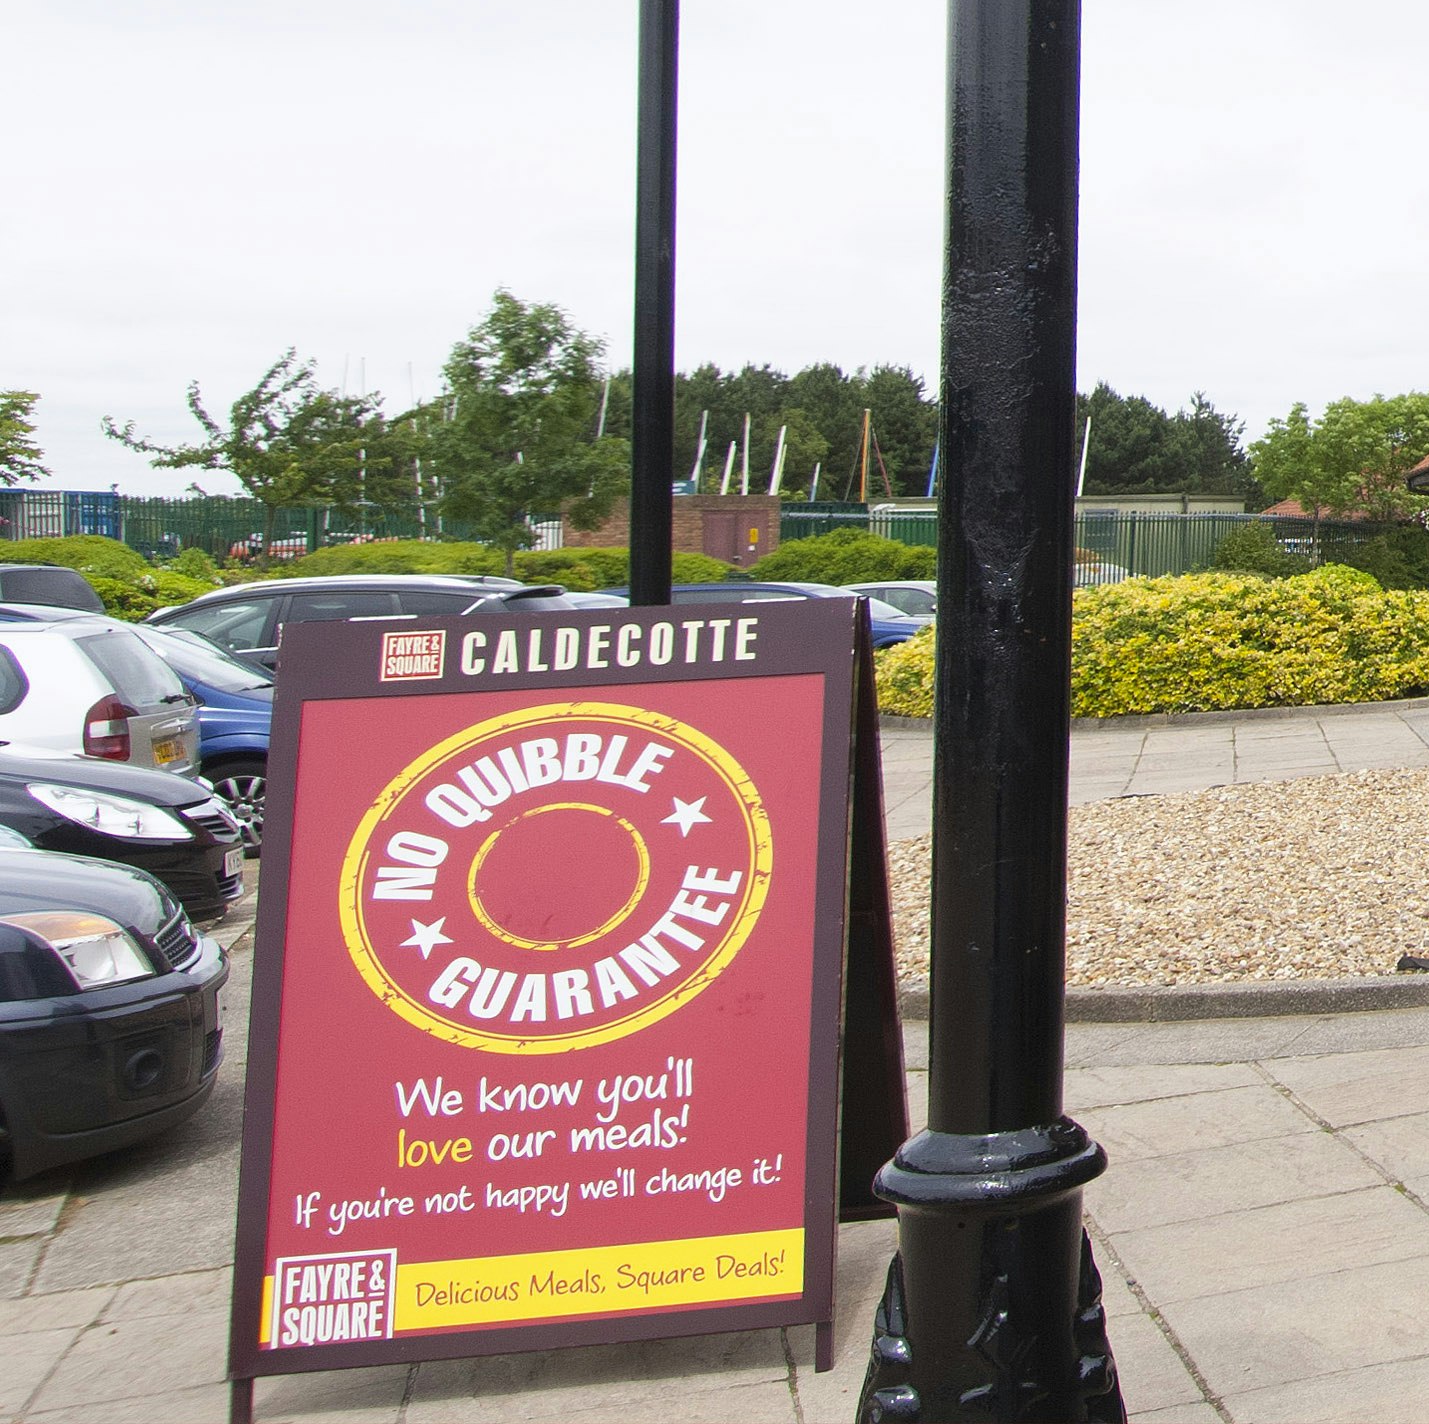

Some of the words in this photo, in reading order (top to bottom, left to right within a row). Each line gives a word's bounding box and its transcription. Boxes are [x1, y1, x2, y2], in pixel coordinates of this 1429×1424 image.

[386, 655, 439, 675] SQUARE
[388, 636, 430, 656] FAYRE
[430, 635, 440, 653] &
[461, 618, 759, 676] CALDECOTTE
[372, 830, 449, 902] NO
[425, 733, 675, 829] QUIBBLE
[427, 864, 743, 1023] GUARANTEE
[396, 1076, 464, 1117] We
[479, 1076, 583, 1114] know
[597, 1057, 694, 1123] you'll
[398, 1129, 473, 1167] love
[487, 1133, 559, 1161] our
[571, 1105, 689, 1154] meals!
[295, 1192, 319, 1228] If
[329, 1188, 414, 1235] you're
[425, 1186, 475, 1214] not
[486, 1176, 569, 1217] happy
[579, 1166, 636, 1199] we'll
[645, 1162, 743, 1203] change
[752, 1154, 783, 1185] it!
[285, 1260, 366, 1305] FAYRE
[368, 1258, 386, 1298] &
[415, 1276, 519, 1308] Delicious
[528, 1268, 605, 1297] Meals,
[616, 1262, 705, 1295] Square
[715, 1249, 786, 1280] Deals!
[281, 1299, 383, 1347] SQUARE
